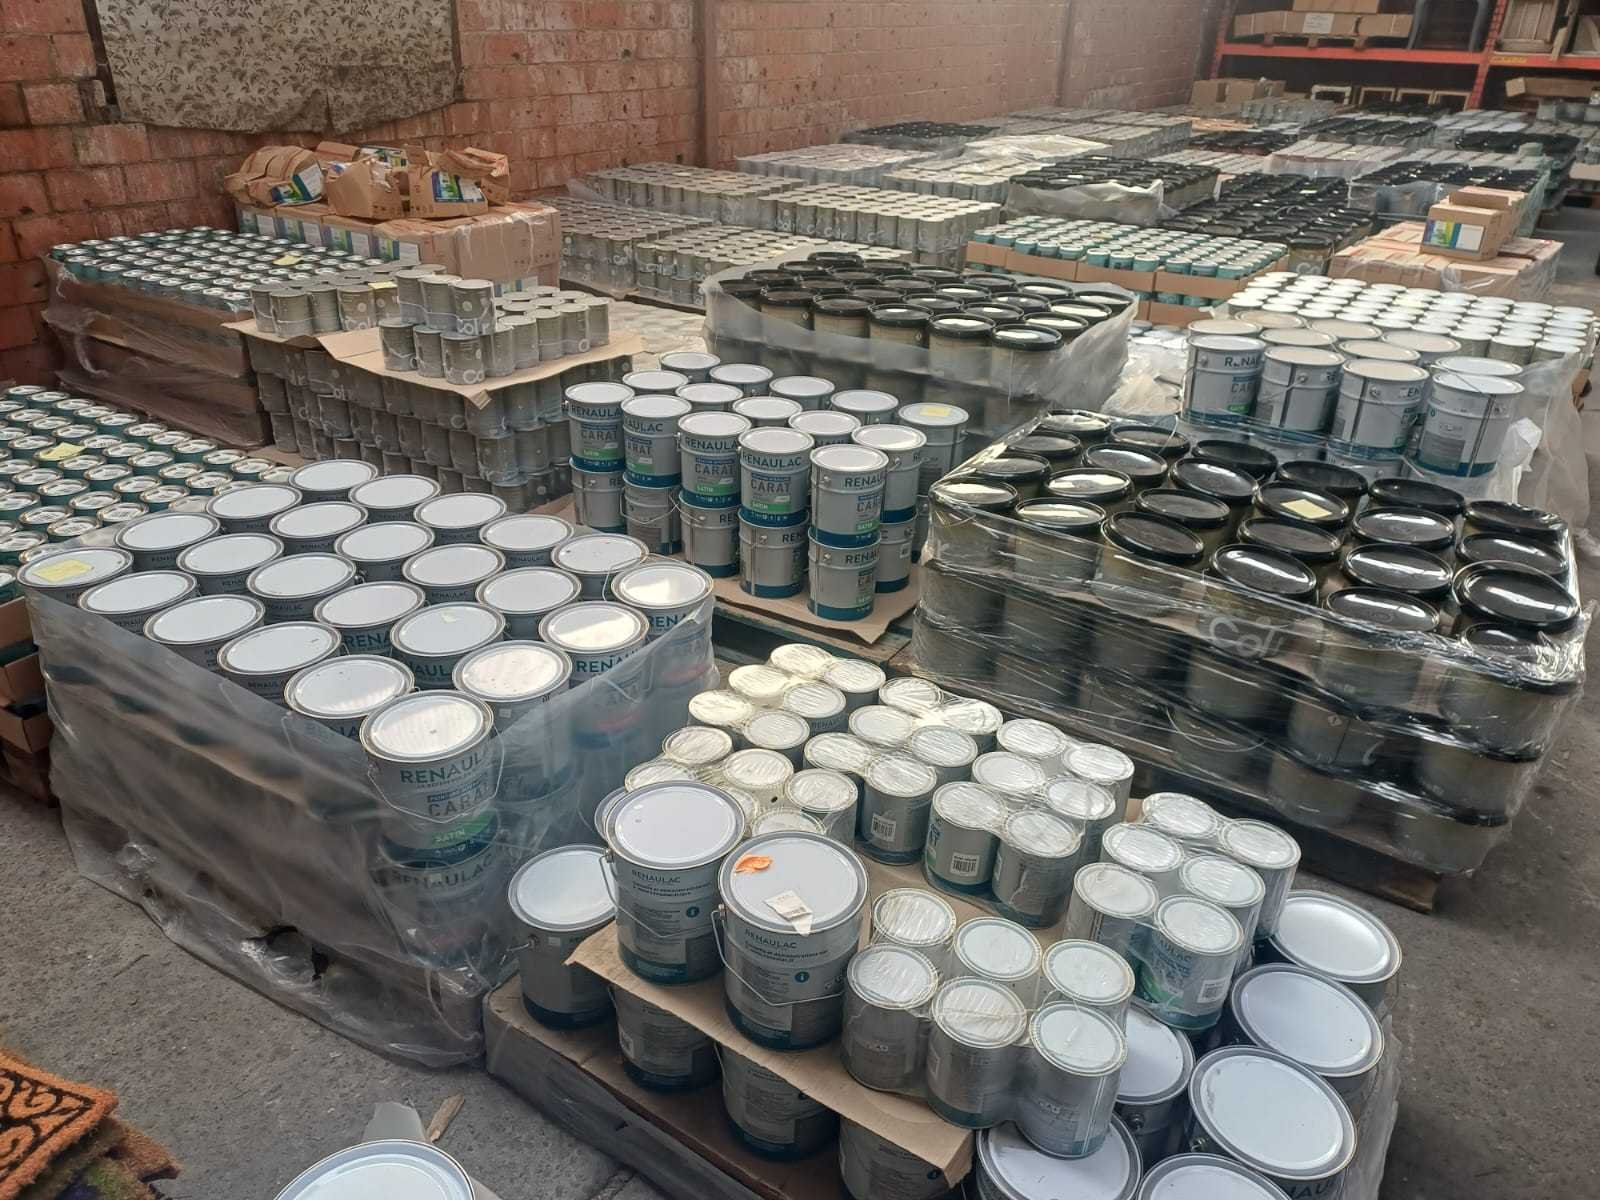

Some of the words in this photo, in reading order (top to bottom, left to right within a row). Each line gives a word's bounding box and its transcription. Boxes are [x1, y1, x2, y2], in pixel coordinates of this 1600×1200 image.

[742, 451, 802, 468] RENAULAC
[695, 462, 735, 476] CARAT
[750, 478, 791, 493] CARAT
